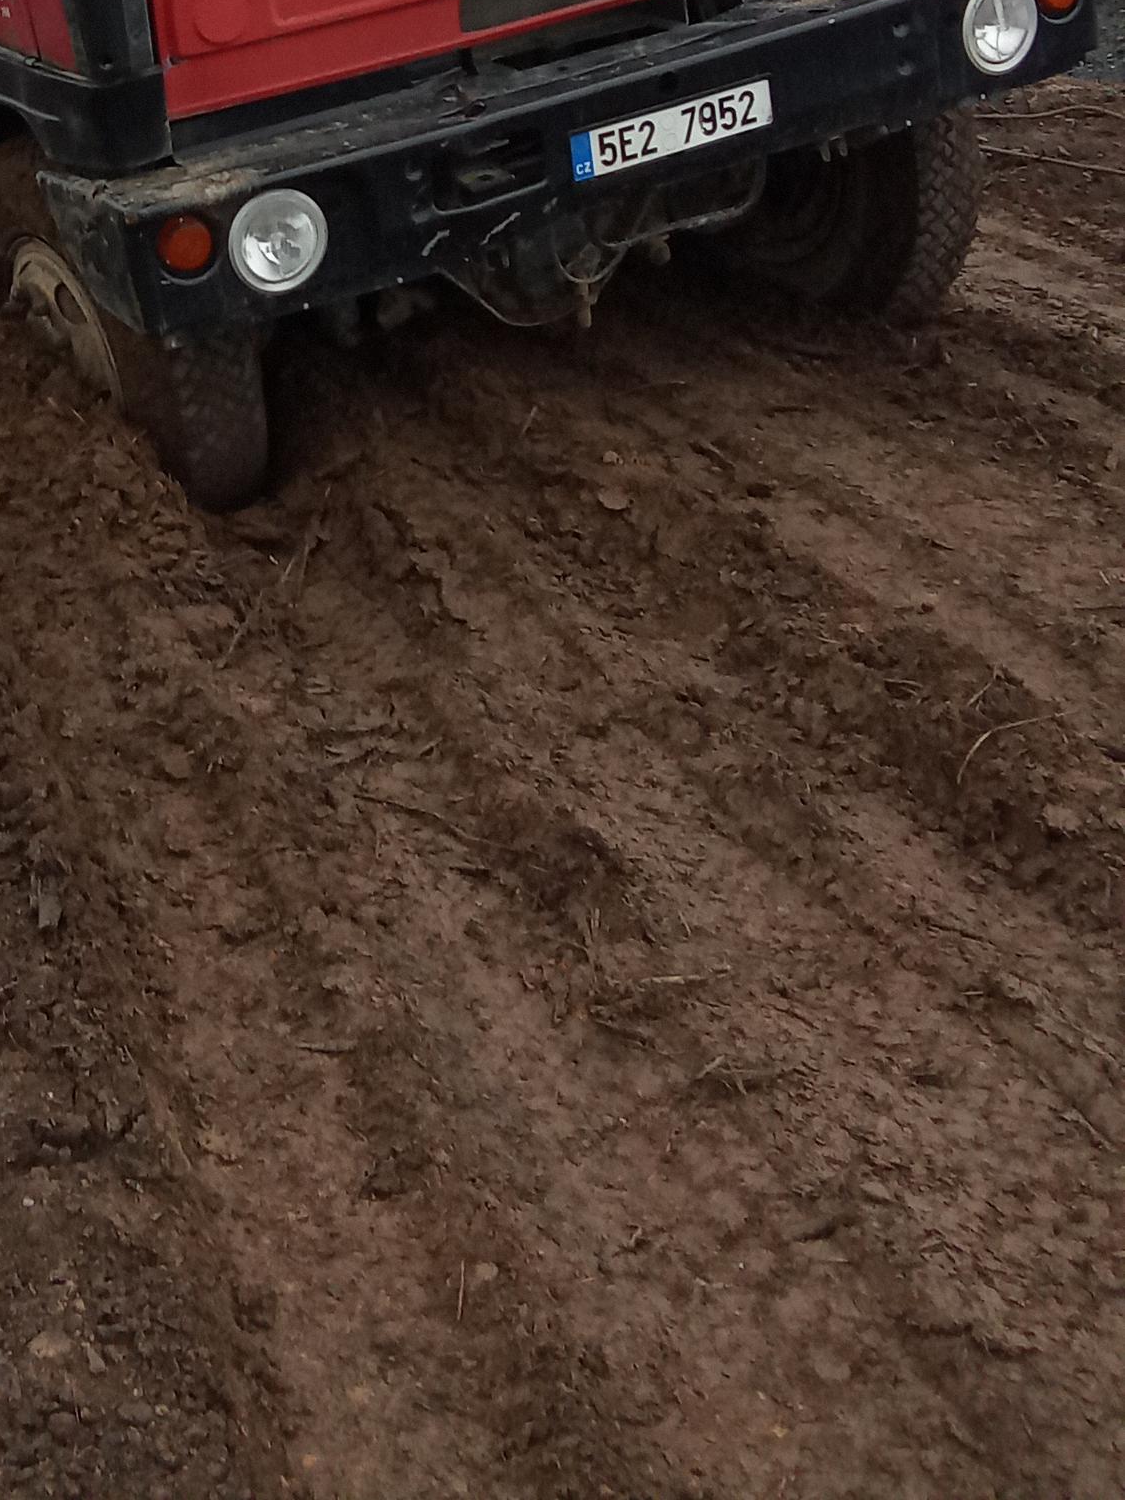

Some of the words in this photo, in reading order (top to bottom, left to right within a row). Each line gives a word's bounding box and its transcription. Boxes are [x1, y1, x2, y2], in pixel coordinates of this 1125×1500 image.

[598, 120, 658, 167] 5E2
[681, 90, 757, 145] 7952
[576, 161, 593, 175] CZ
